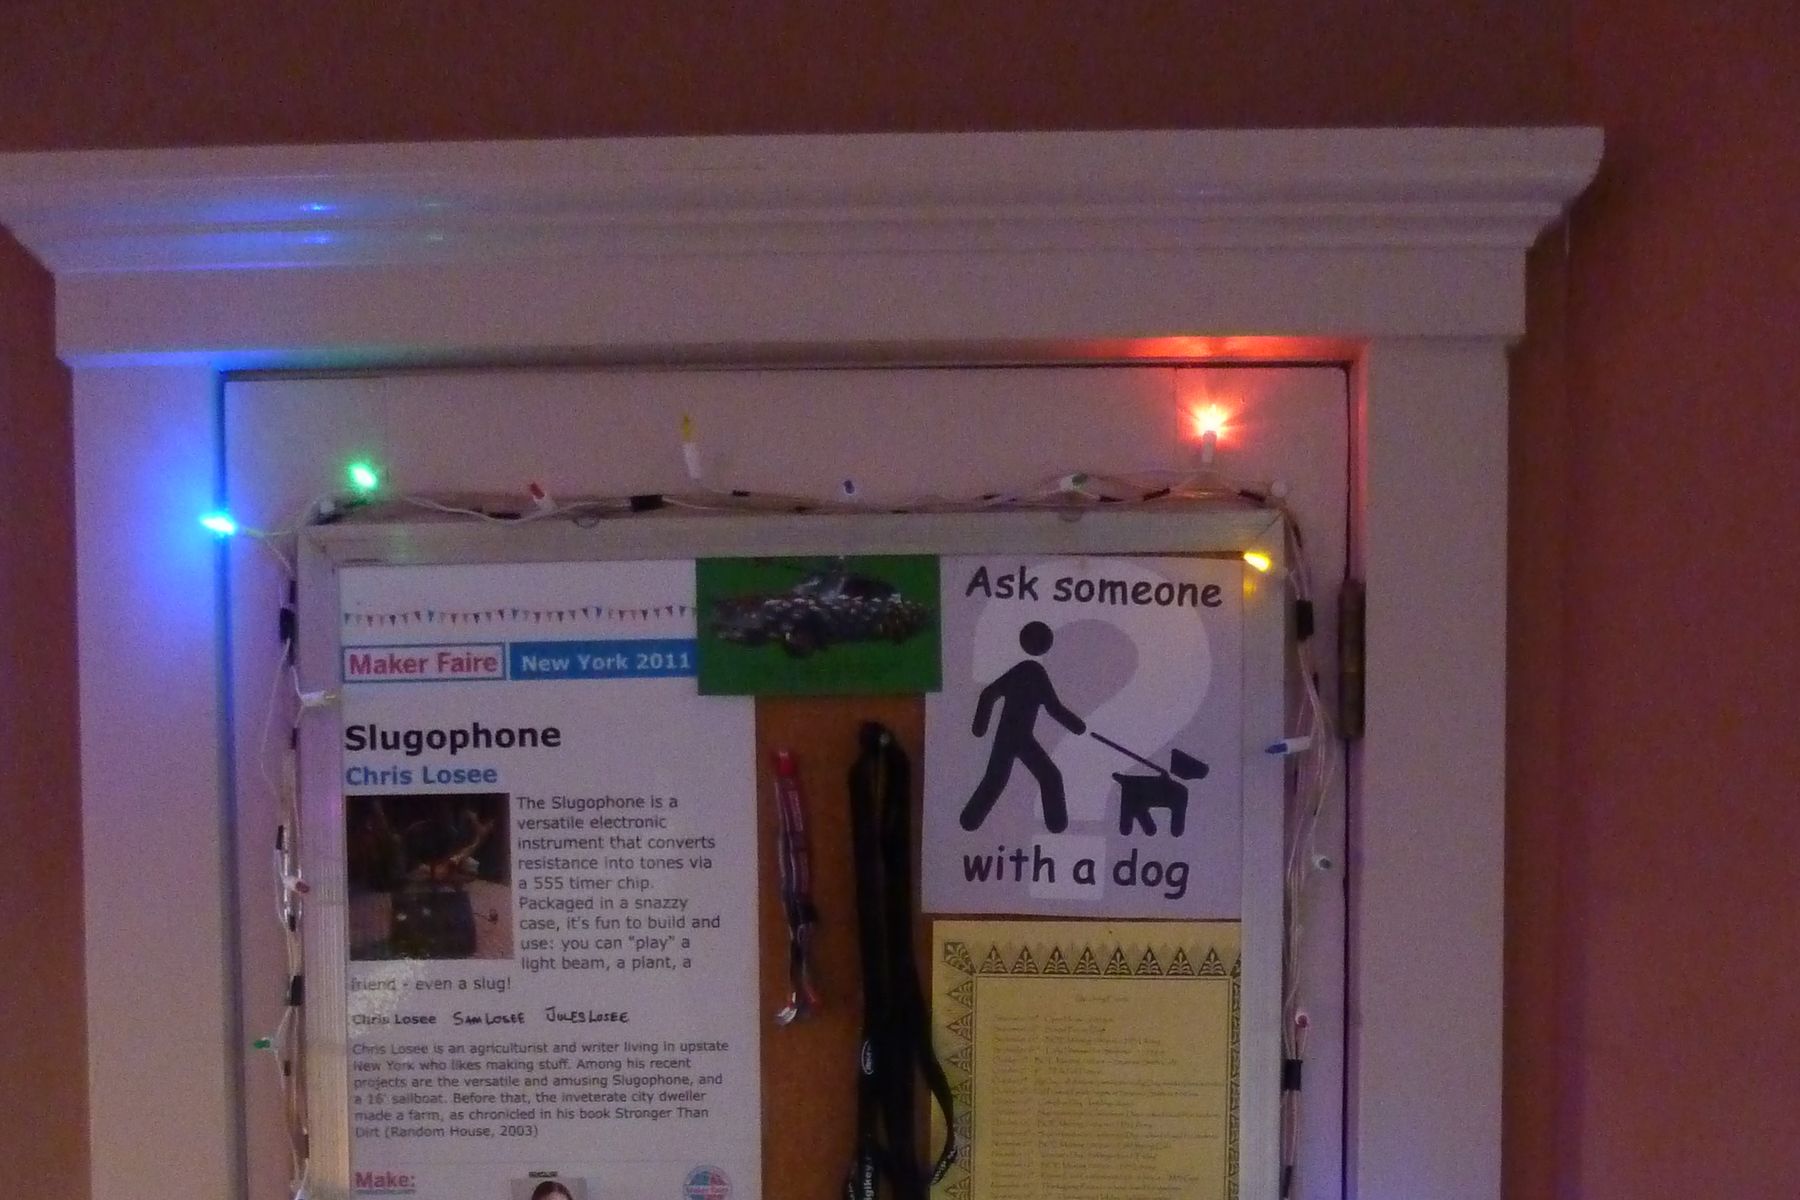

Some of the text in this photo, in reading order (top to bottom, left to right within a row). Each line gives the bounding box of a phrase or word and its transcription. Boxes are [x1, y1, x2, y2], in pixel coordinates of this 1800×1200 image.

[966, 566, 1223, 608] Ask someone
[349, 653, 690, 676] Maker Faire New York 2011
[345, 723, 561, 755] Slugophone
[346, 765, 497, 786] Chris Losee
[518, 796, 678, 812] The Slugophone is a
[518, 815, 666, 830] versatile electronic
[518, 836, 715, 850] instrument that converts
[519, 856, 712, 870] resistance into tones via
[964, 845, 1189, 900] with a dog
[519, 876, 653, 892] a 555 timer chip.
[520, 897, 688, 912] Packaged in a snazzy
[520, 916, 720, 931] case, it's fun to build and
[521, 935, 690, 952] use: you can "play" a
[521, 956, 691, 972] light beam, a plant, a
[416, 978, 452, 990] even
[458, 979, 467, 990] a
[474, 977, 511, 994] slug!
[353, 1042, 729, 1056] Chris Losee is an agriculturist and writer living in upstate
[354, 1059, 692, 1072] New York who likes making stuff. Among his recent
[354, 1074, 722, 1090] projects are the versatile and amusing Slugophone, and
[354, 1096, 361, 1105] a
[392, 1093, 446, 1104] sailboat.
[454, 1093, 496, 1103] Before
[500, 1092, 530, 1104] that,
[536, 1092, 556, 1103] the
[562, 1092, 626, 1102] inveterate
[632, 1091, 654, 1104] city
[659, 1091, 706, 1101] dweller
[355, 1107, 708, 1122] made a farm, as chronicled in his book Stronger Than
[356, 1125, 538, 1139] Dirt (Random House, 2003)
[356, 1172, 415, 1187] Make:
